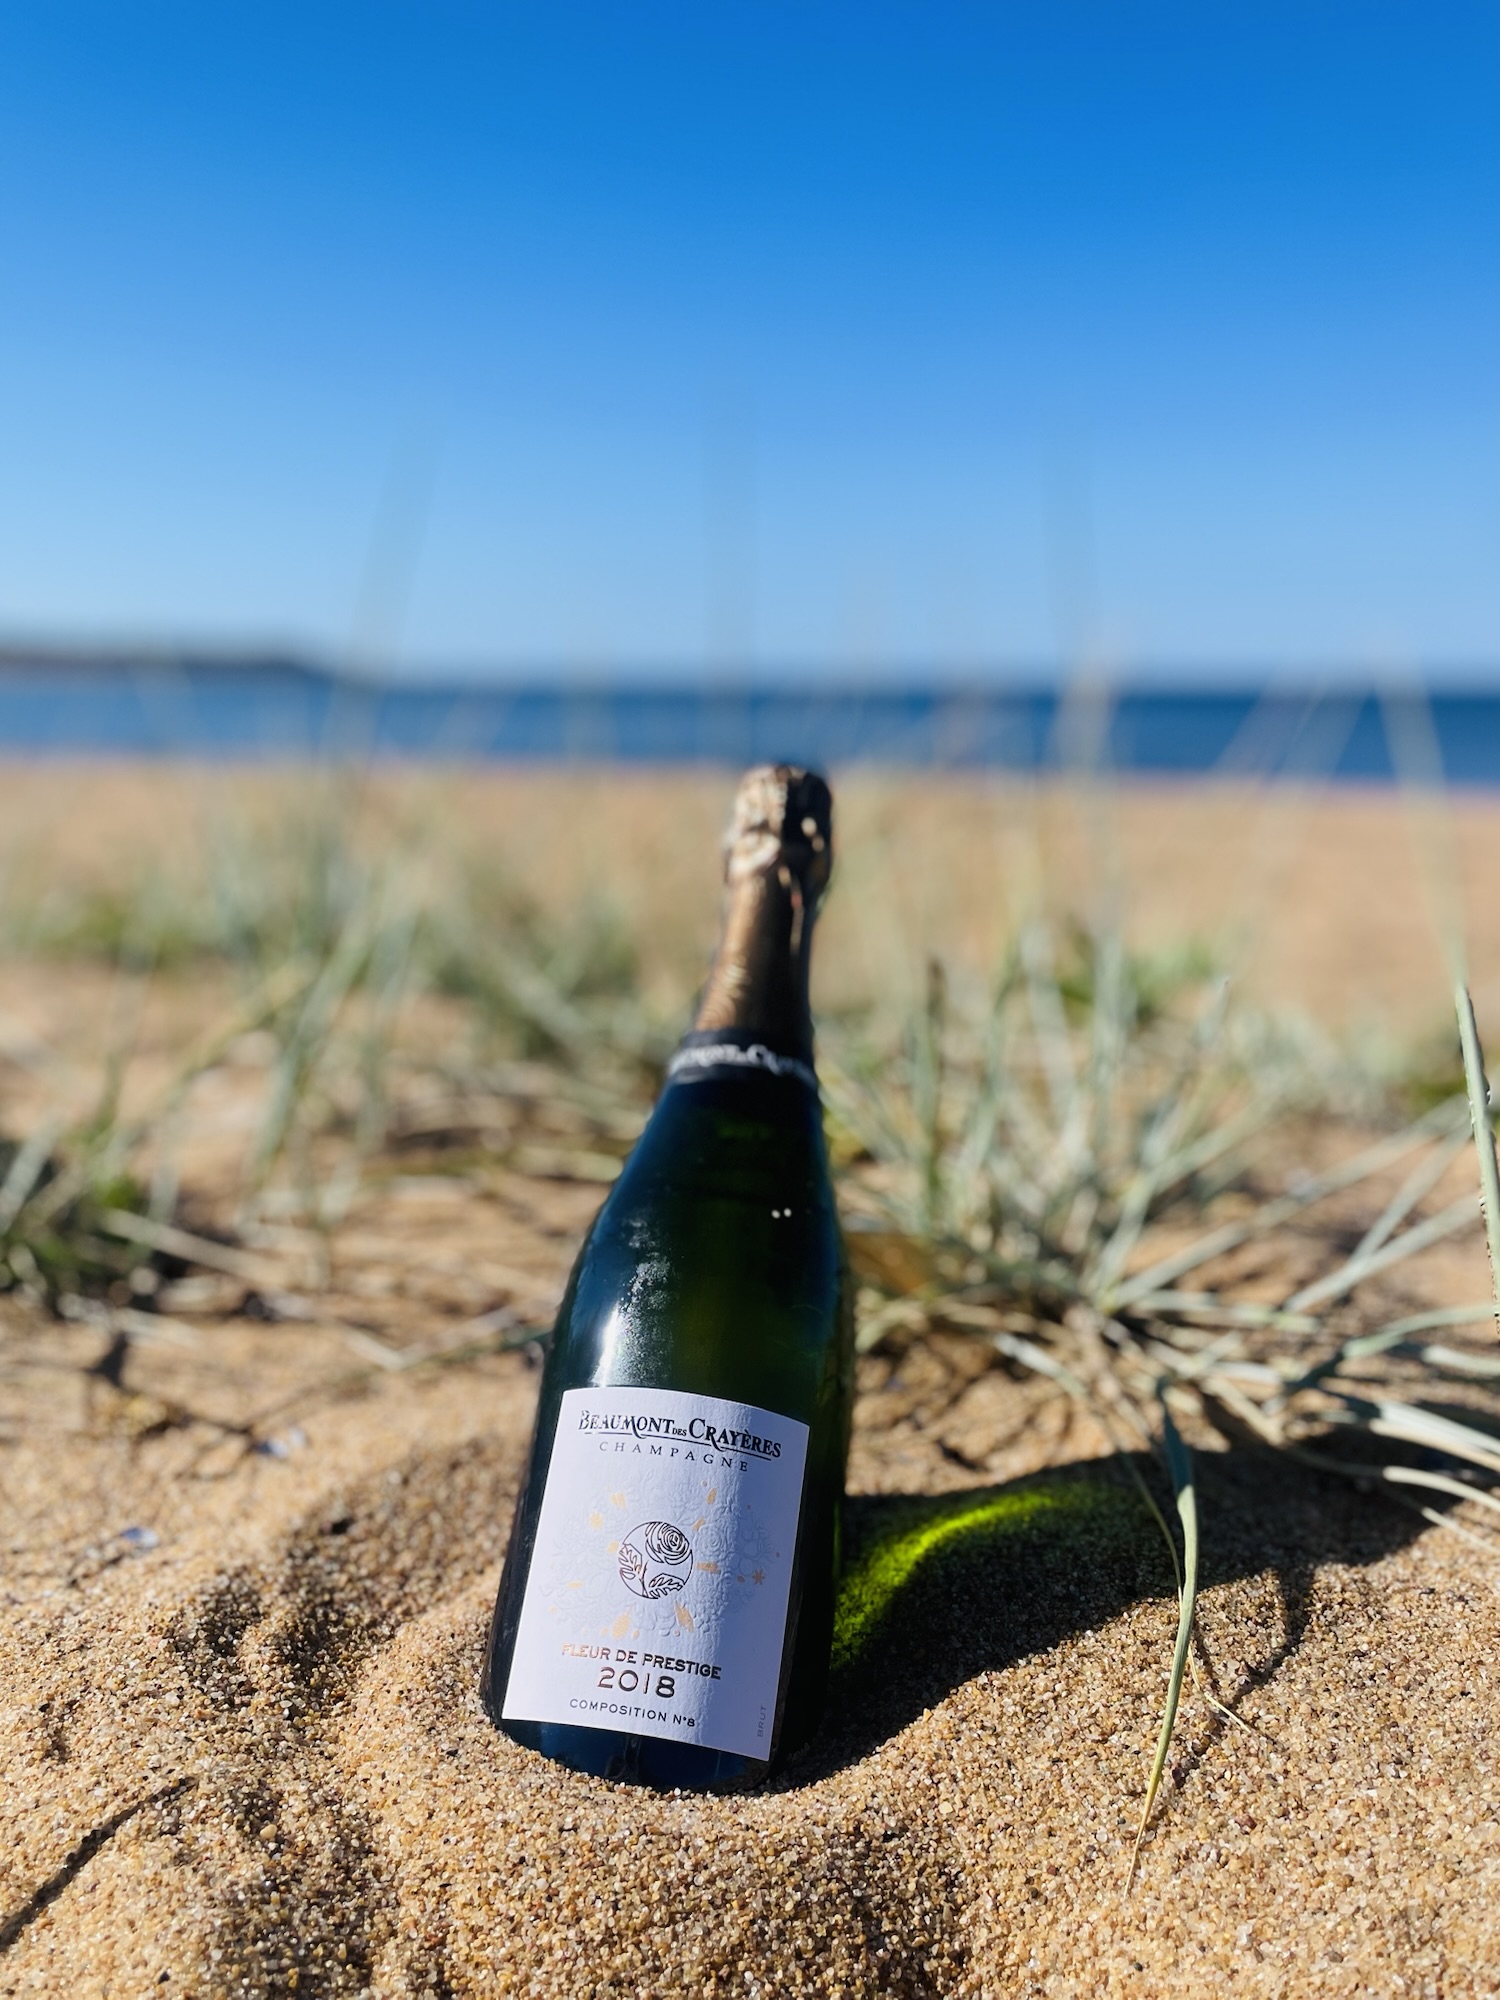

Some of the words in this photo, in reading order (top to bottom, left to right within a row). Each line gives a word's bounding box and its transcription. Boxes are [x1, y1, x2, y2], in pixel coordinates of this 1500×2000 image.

[578, 1410, 674, 1439] BEAUMONT
[672, 1427, 687, 1437] DES
[689, 1418, 782, 1458] CRAYÈRES
[599, 1441, 748, 1472] CHAMPAGNE
[561, 1642, 611, 1661] FLEUR
[615, 1649, 638, 1664] DE
[642, 1653, 722, 1680] PRESTIGE
[597, 1666, 676, 1699] 2018
[569, 1698, 667, 1722] COMPOSITION
[757, 1704, 768, 1738] BRUT
